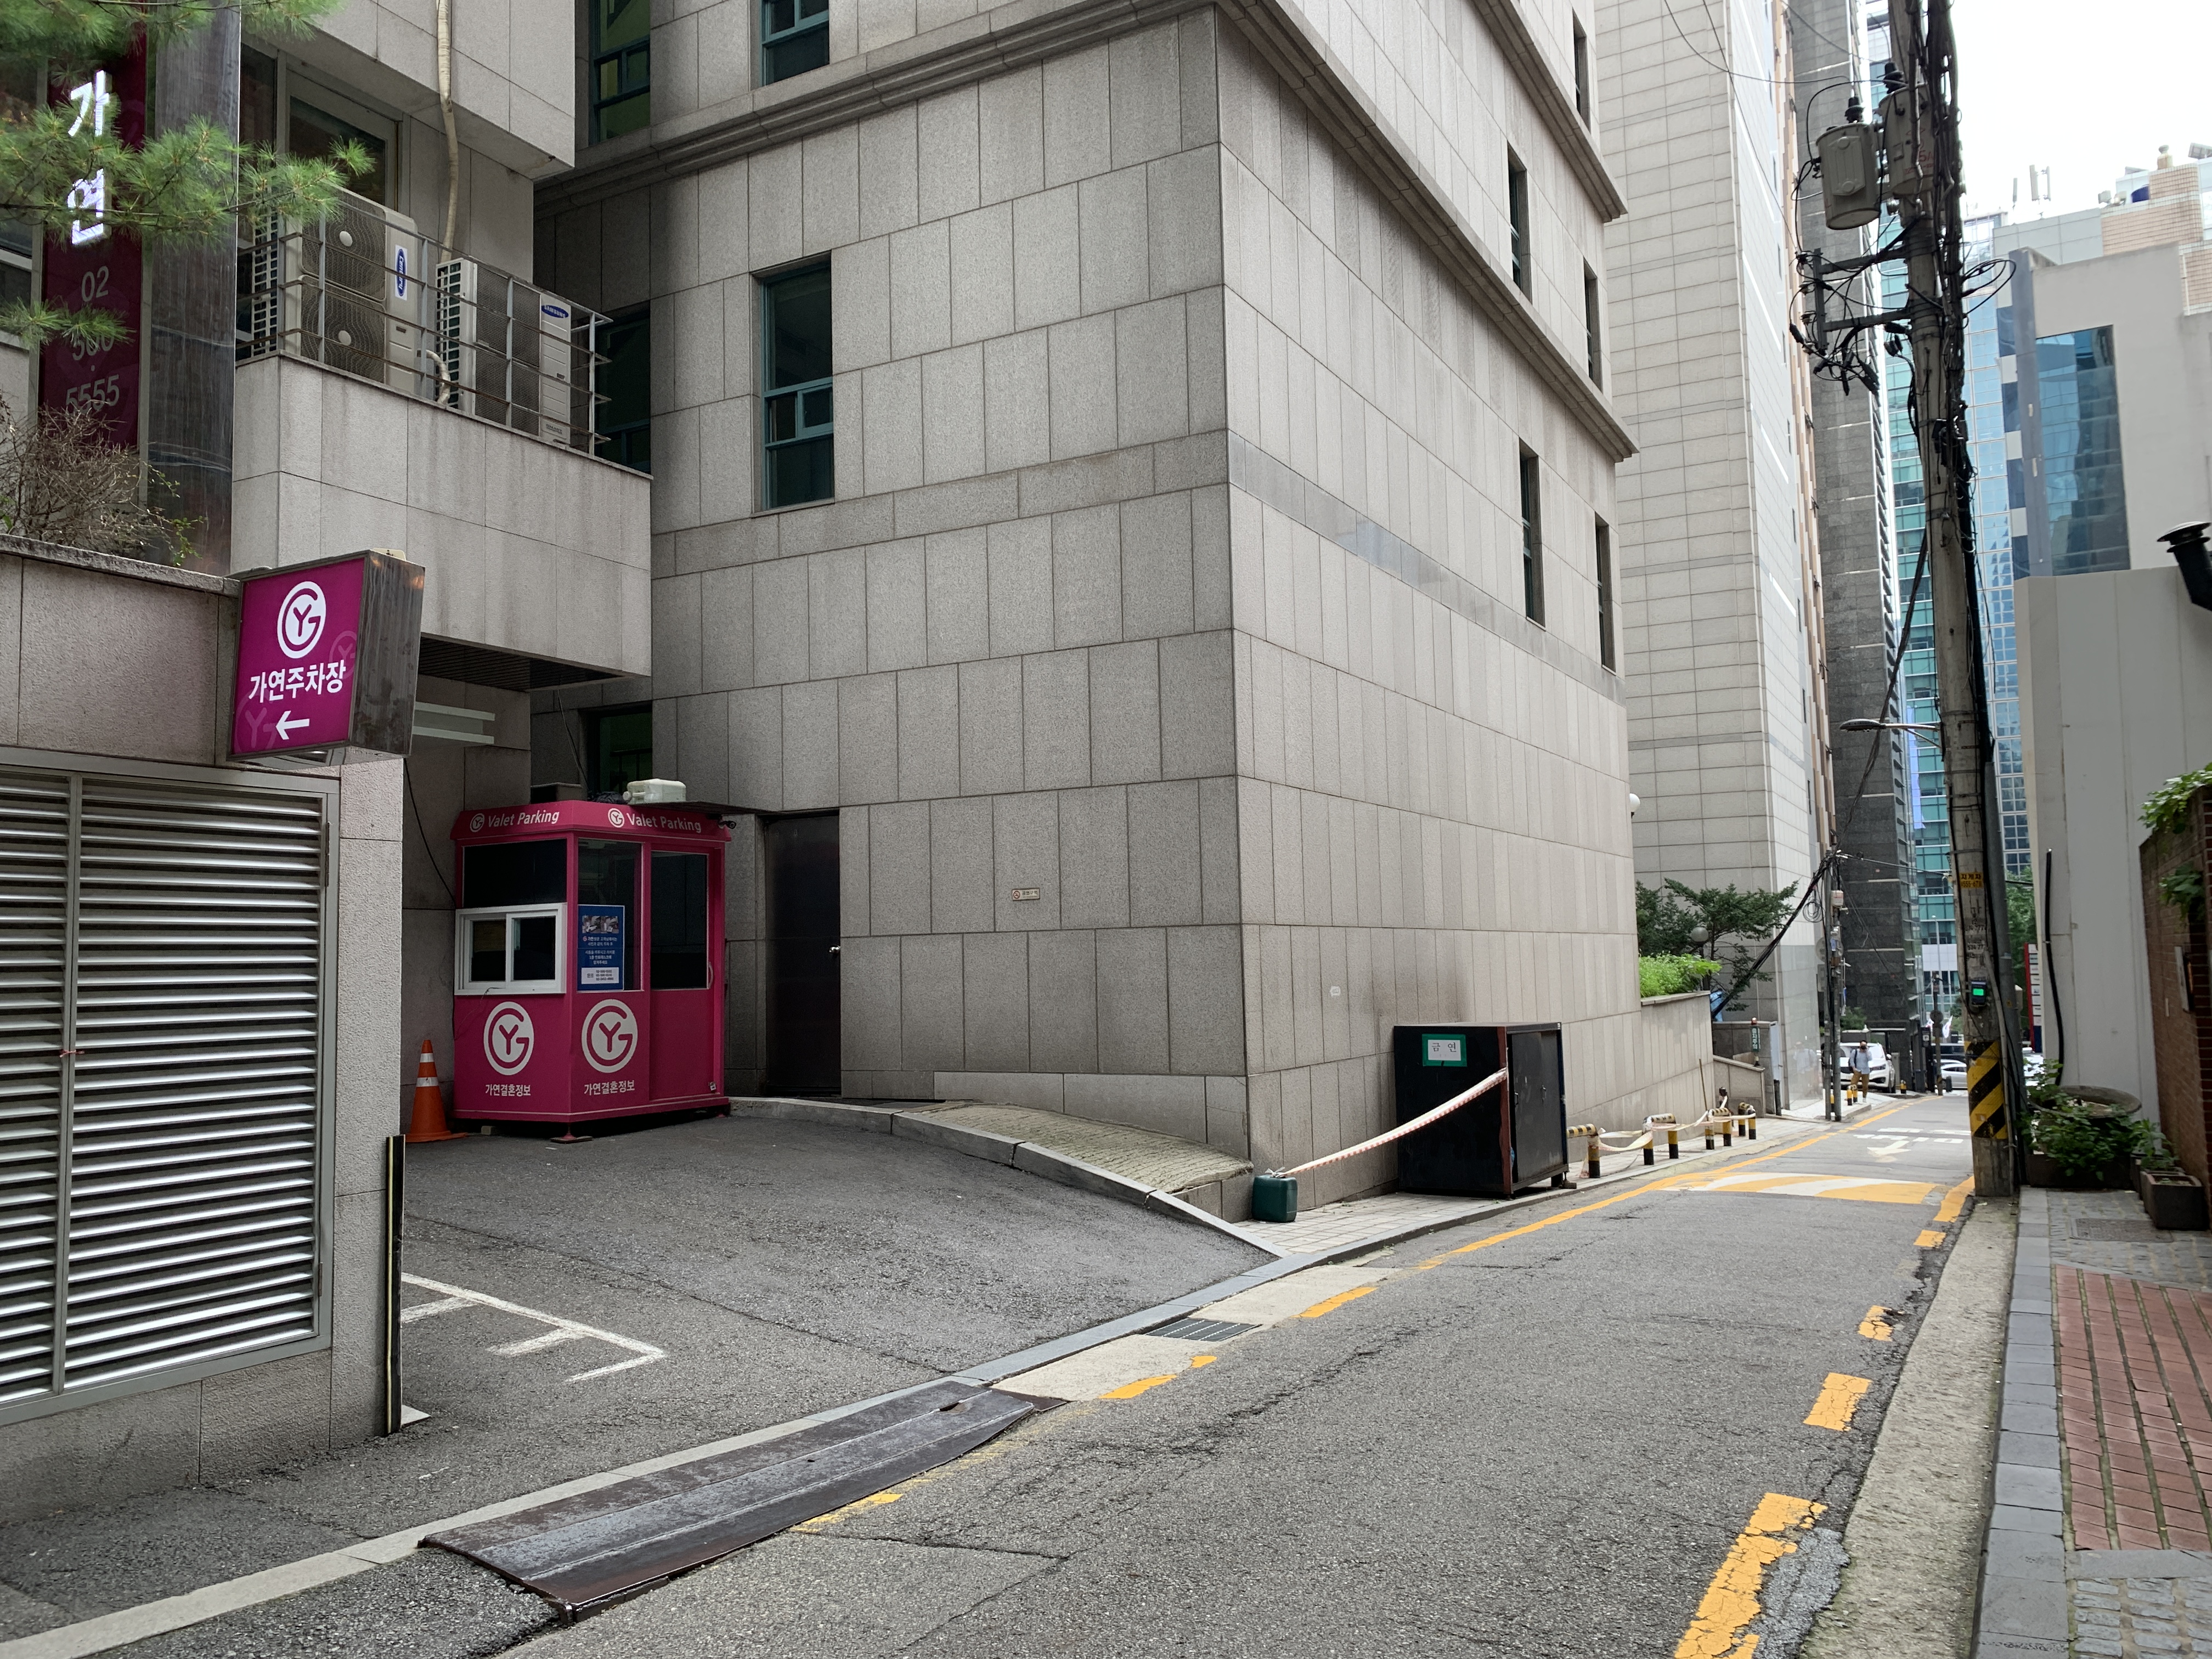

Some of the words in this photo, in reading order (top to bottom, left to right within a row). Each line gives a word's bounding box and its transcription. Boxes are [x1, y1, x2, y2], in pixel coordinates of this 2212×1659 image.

[81, 266, 109, 302] 02
[544, 305, 566, 318] SAMSUNG
[66, 375, 120, 417] 5555
[249, 659, 346, 703] 가연주차장
[488, 814, 515, 827] Valet
[517, 810, 560, 826] Parking
[627, 812, 657, 828] Valet
[661, 816, 702, 834] Parking
[485, 1084, 531, 1097] 가연결혼정보
[584, 1080, 635, 1096] 가연결혼정보
